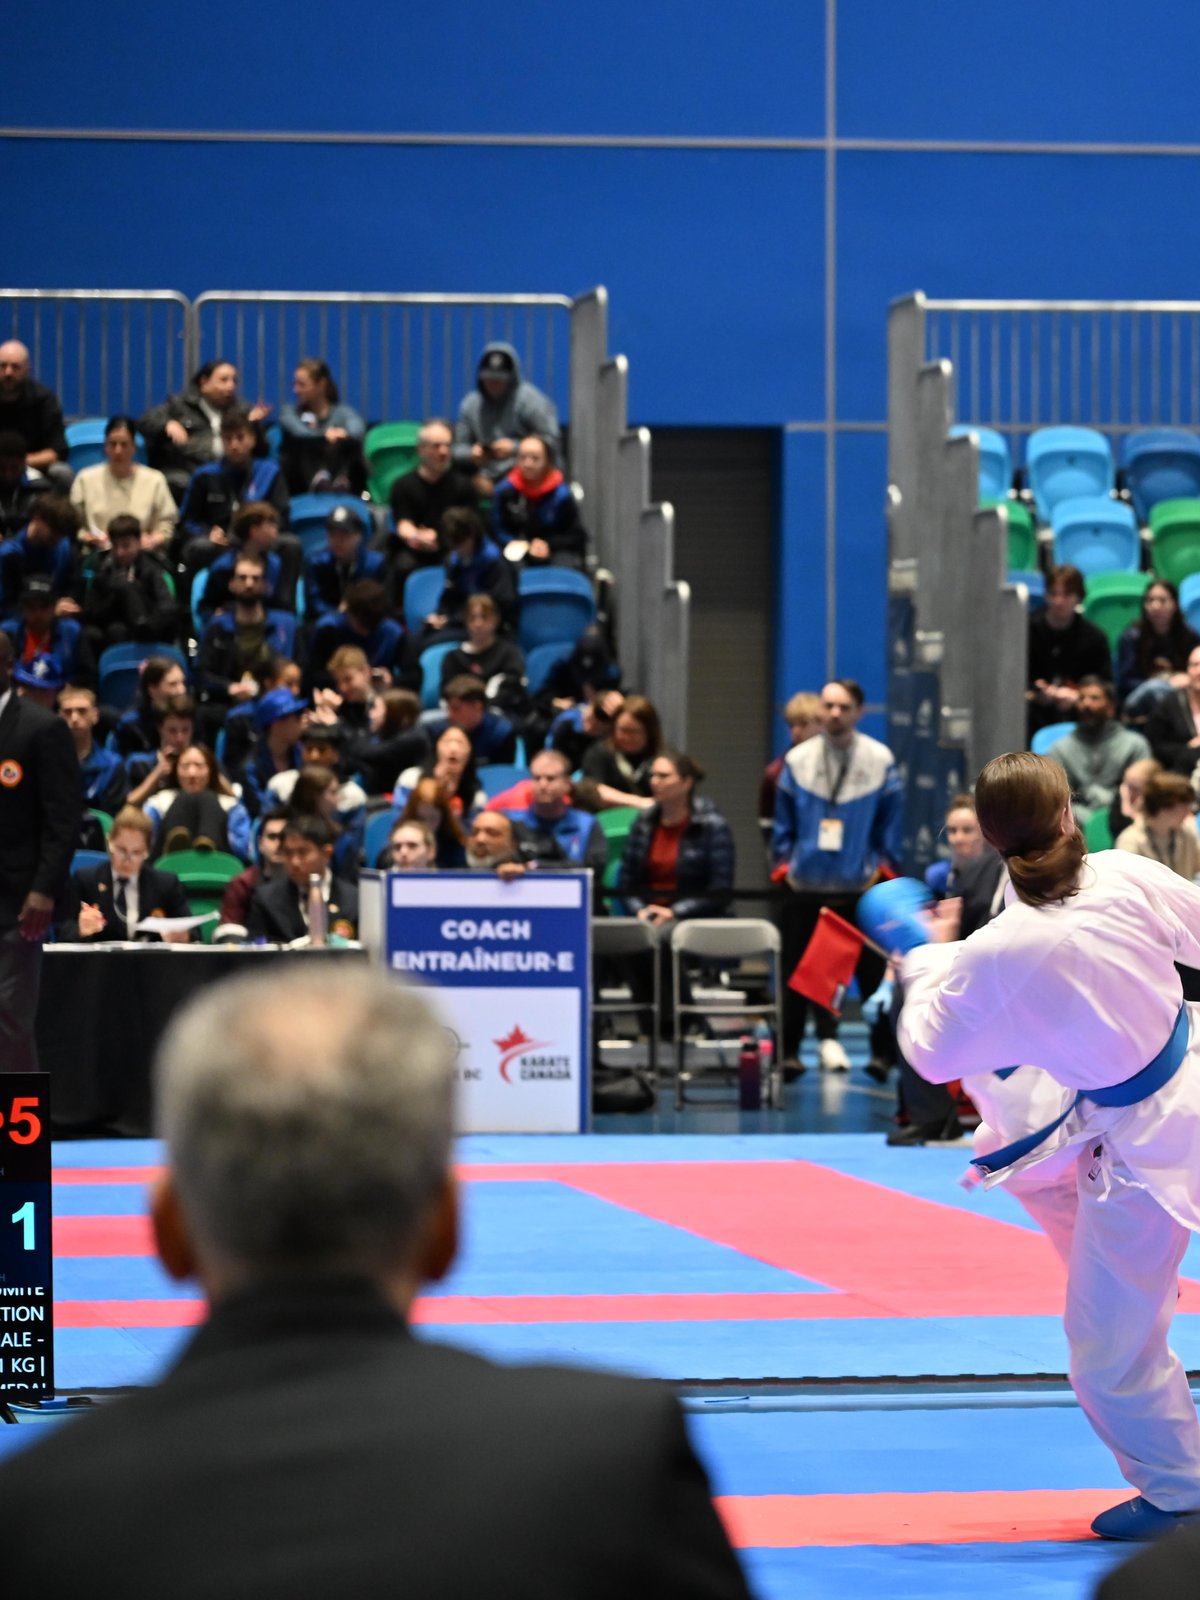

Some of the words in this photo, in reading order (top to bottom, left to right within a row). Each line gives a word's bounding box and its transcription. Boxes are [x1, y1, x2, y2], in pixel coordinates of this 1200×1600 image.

[441, 920, 530, 940] COACH
[12, 1202, 36, 1250] 1
[1, 1332, 32, 1348] ALE
[11, 1357, 35, 1373] KG
